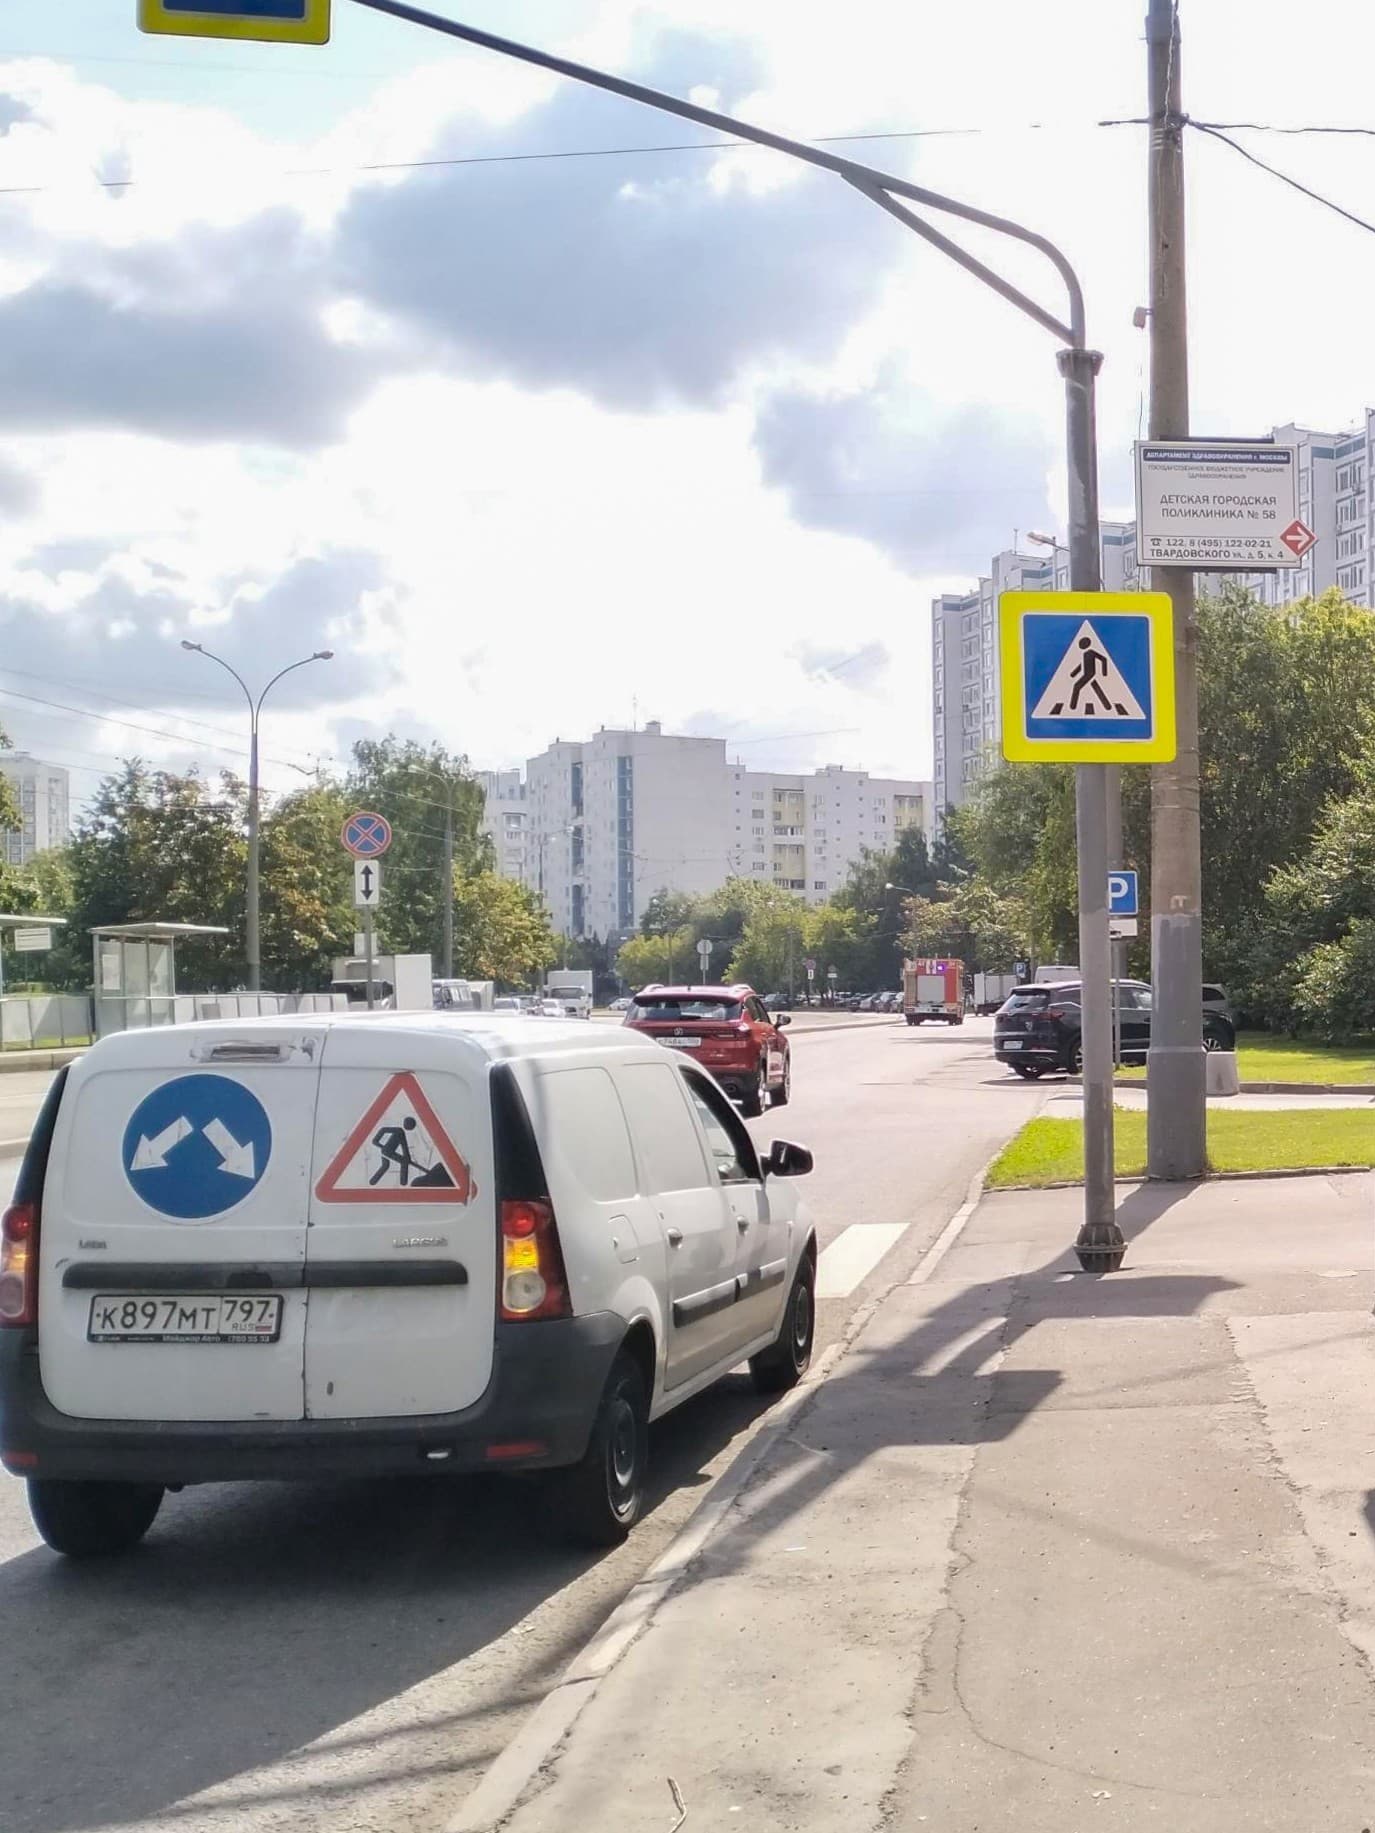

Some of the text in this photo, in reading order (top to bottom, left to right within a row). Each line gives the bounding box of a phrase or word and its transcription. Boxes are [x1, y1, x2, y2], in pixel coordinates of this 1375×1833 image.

[1160, 494, 1277, 507] ДЕТСКАЯ ГОРОДСКАЯ
[1162, 508, 1276, 520] ПОЛИКЛИНИКА № 58
[1197, 539, 1223, 549] (495)
[1225, 540, 1272, 549] 122-02-21
[1150, 549, 1231, 559] ТВАРДОВСКОГО
[1277, 551, 1284, 559] 4
[1107, 877, 1129, 910] P
[223, 1299, 272, 1322] 797
[231, 1323, 256, 1331] RUS
